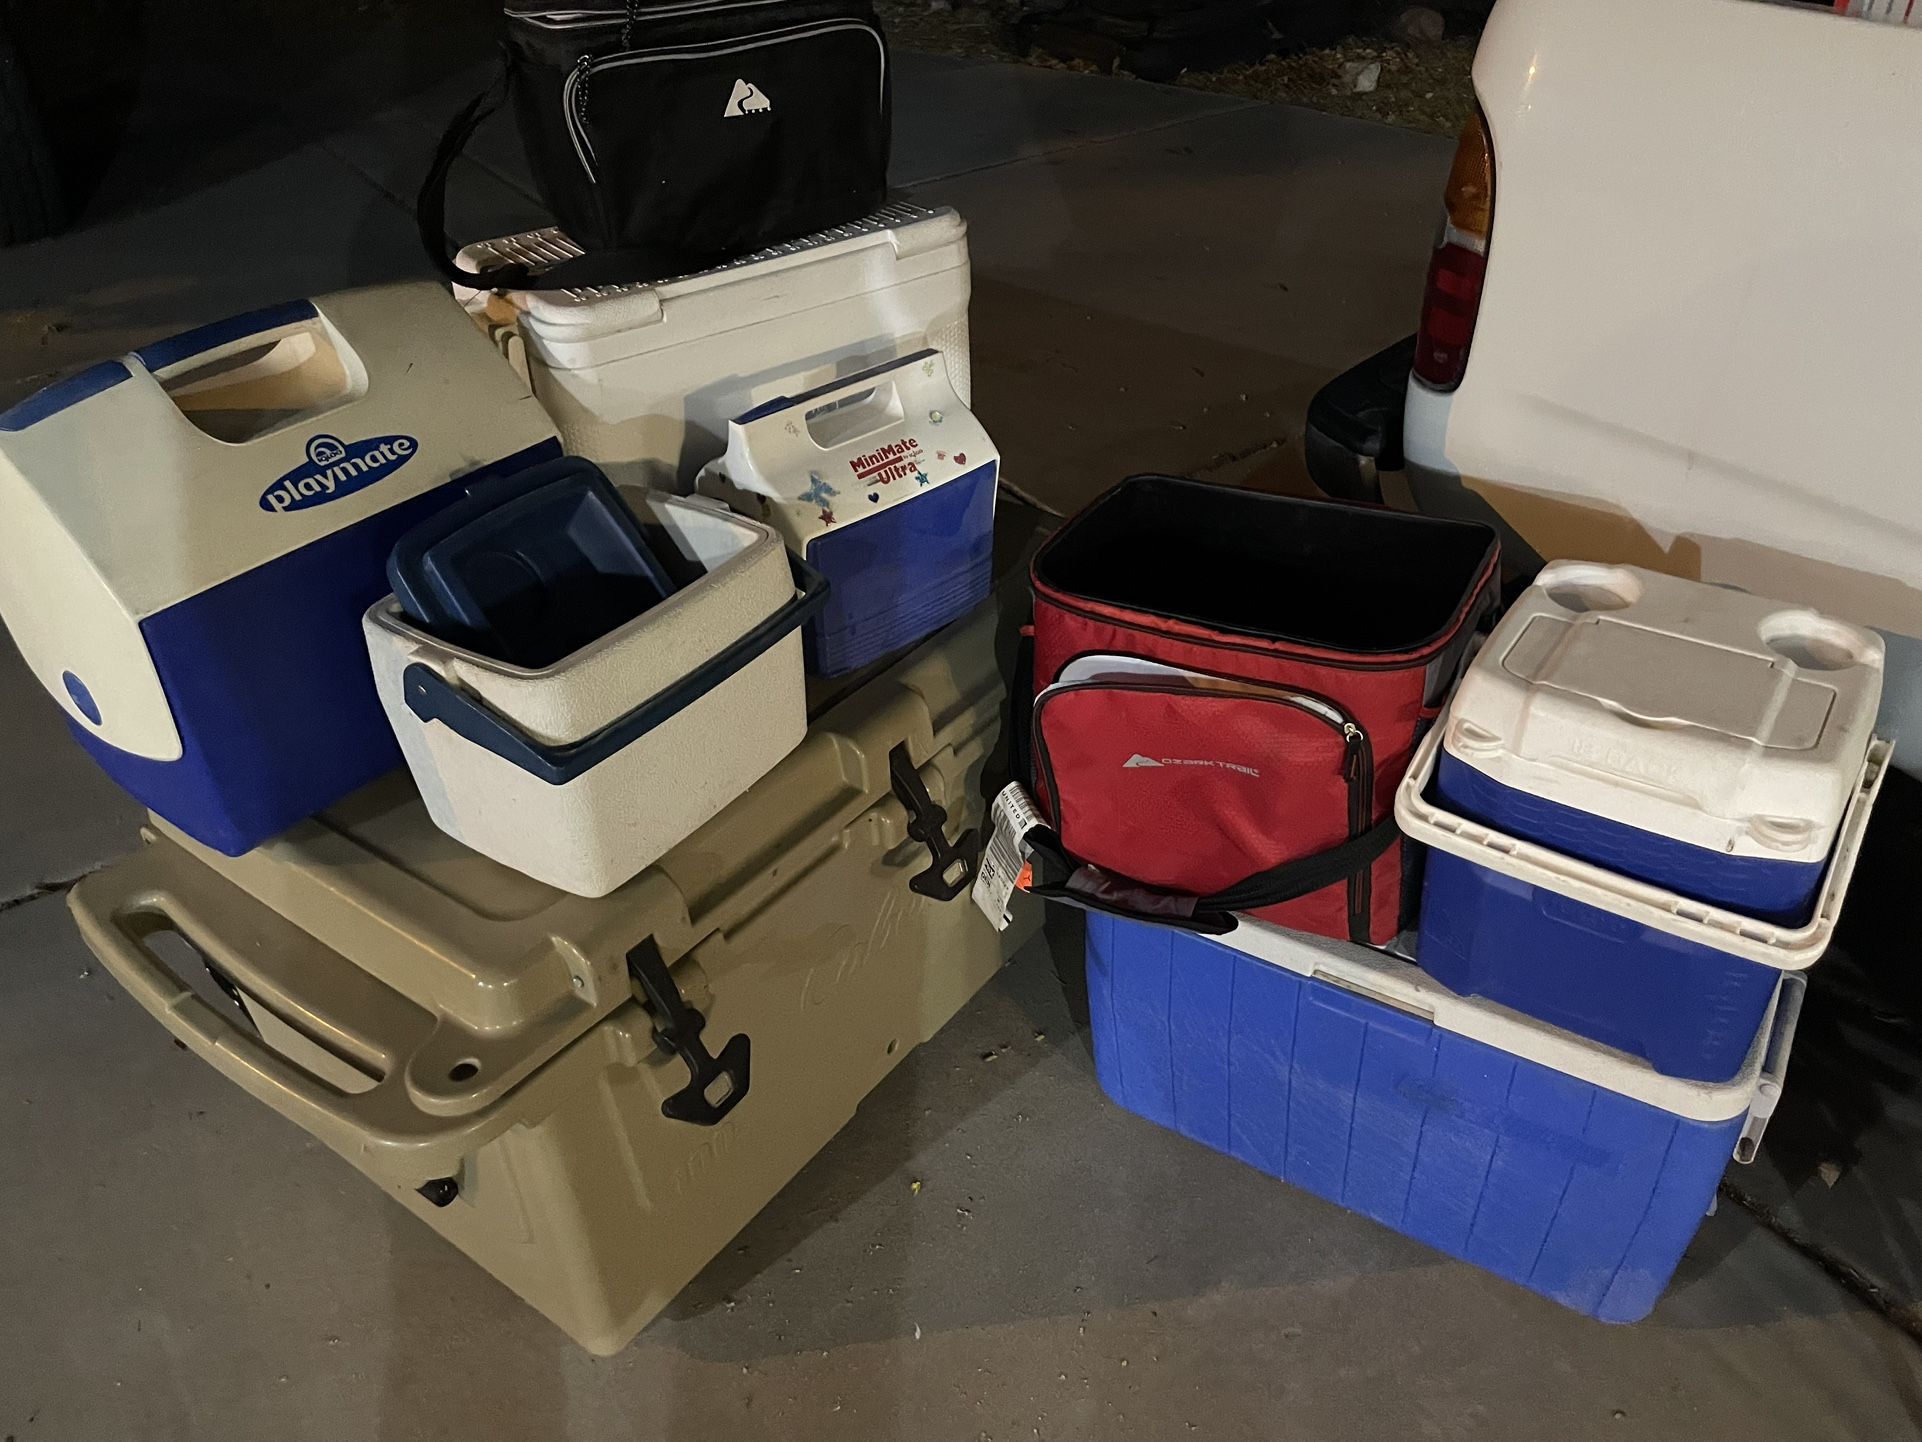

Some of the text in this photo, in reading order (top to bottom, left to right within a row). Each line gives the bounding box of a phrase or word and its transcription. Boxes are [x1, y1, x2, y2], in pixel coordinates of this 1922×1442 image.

[849, 438, 918, 473] MiniMate
[878, 461, 917, 485] Ultra
[266, 439, 413, 512] playmate
